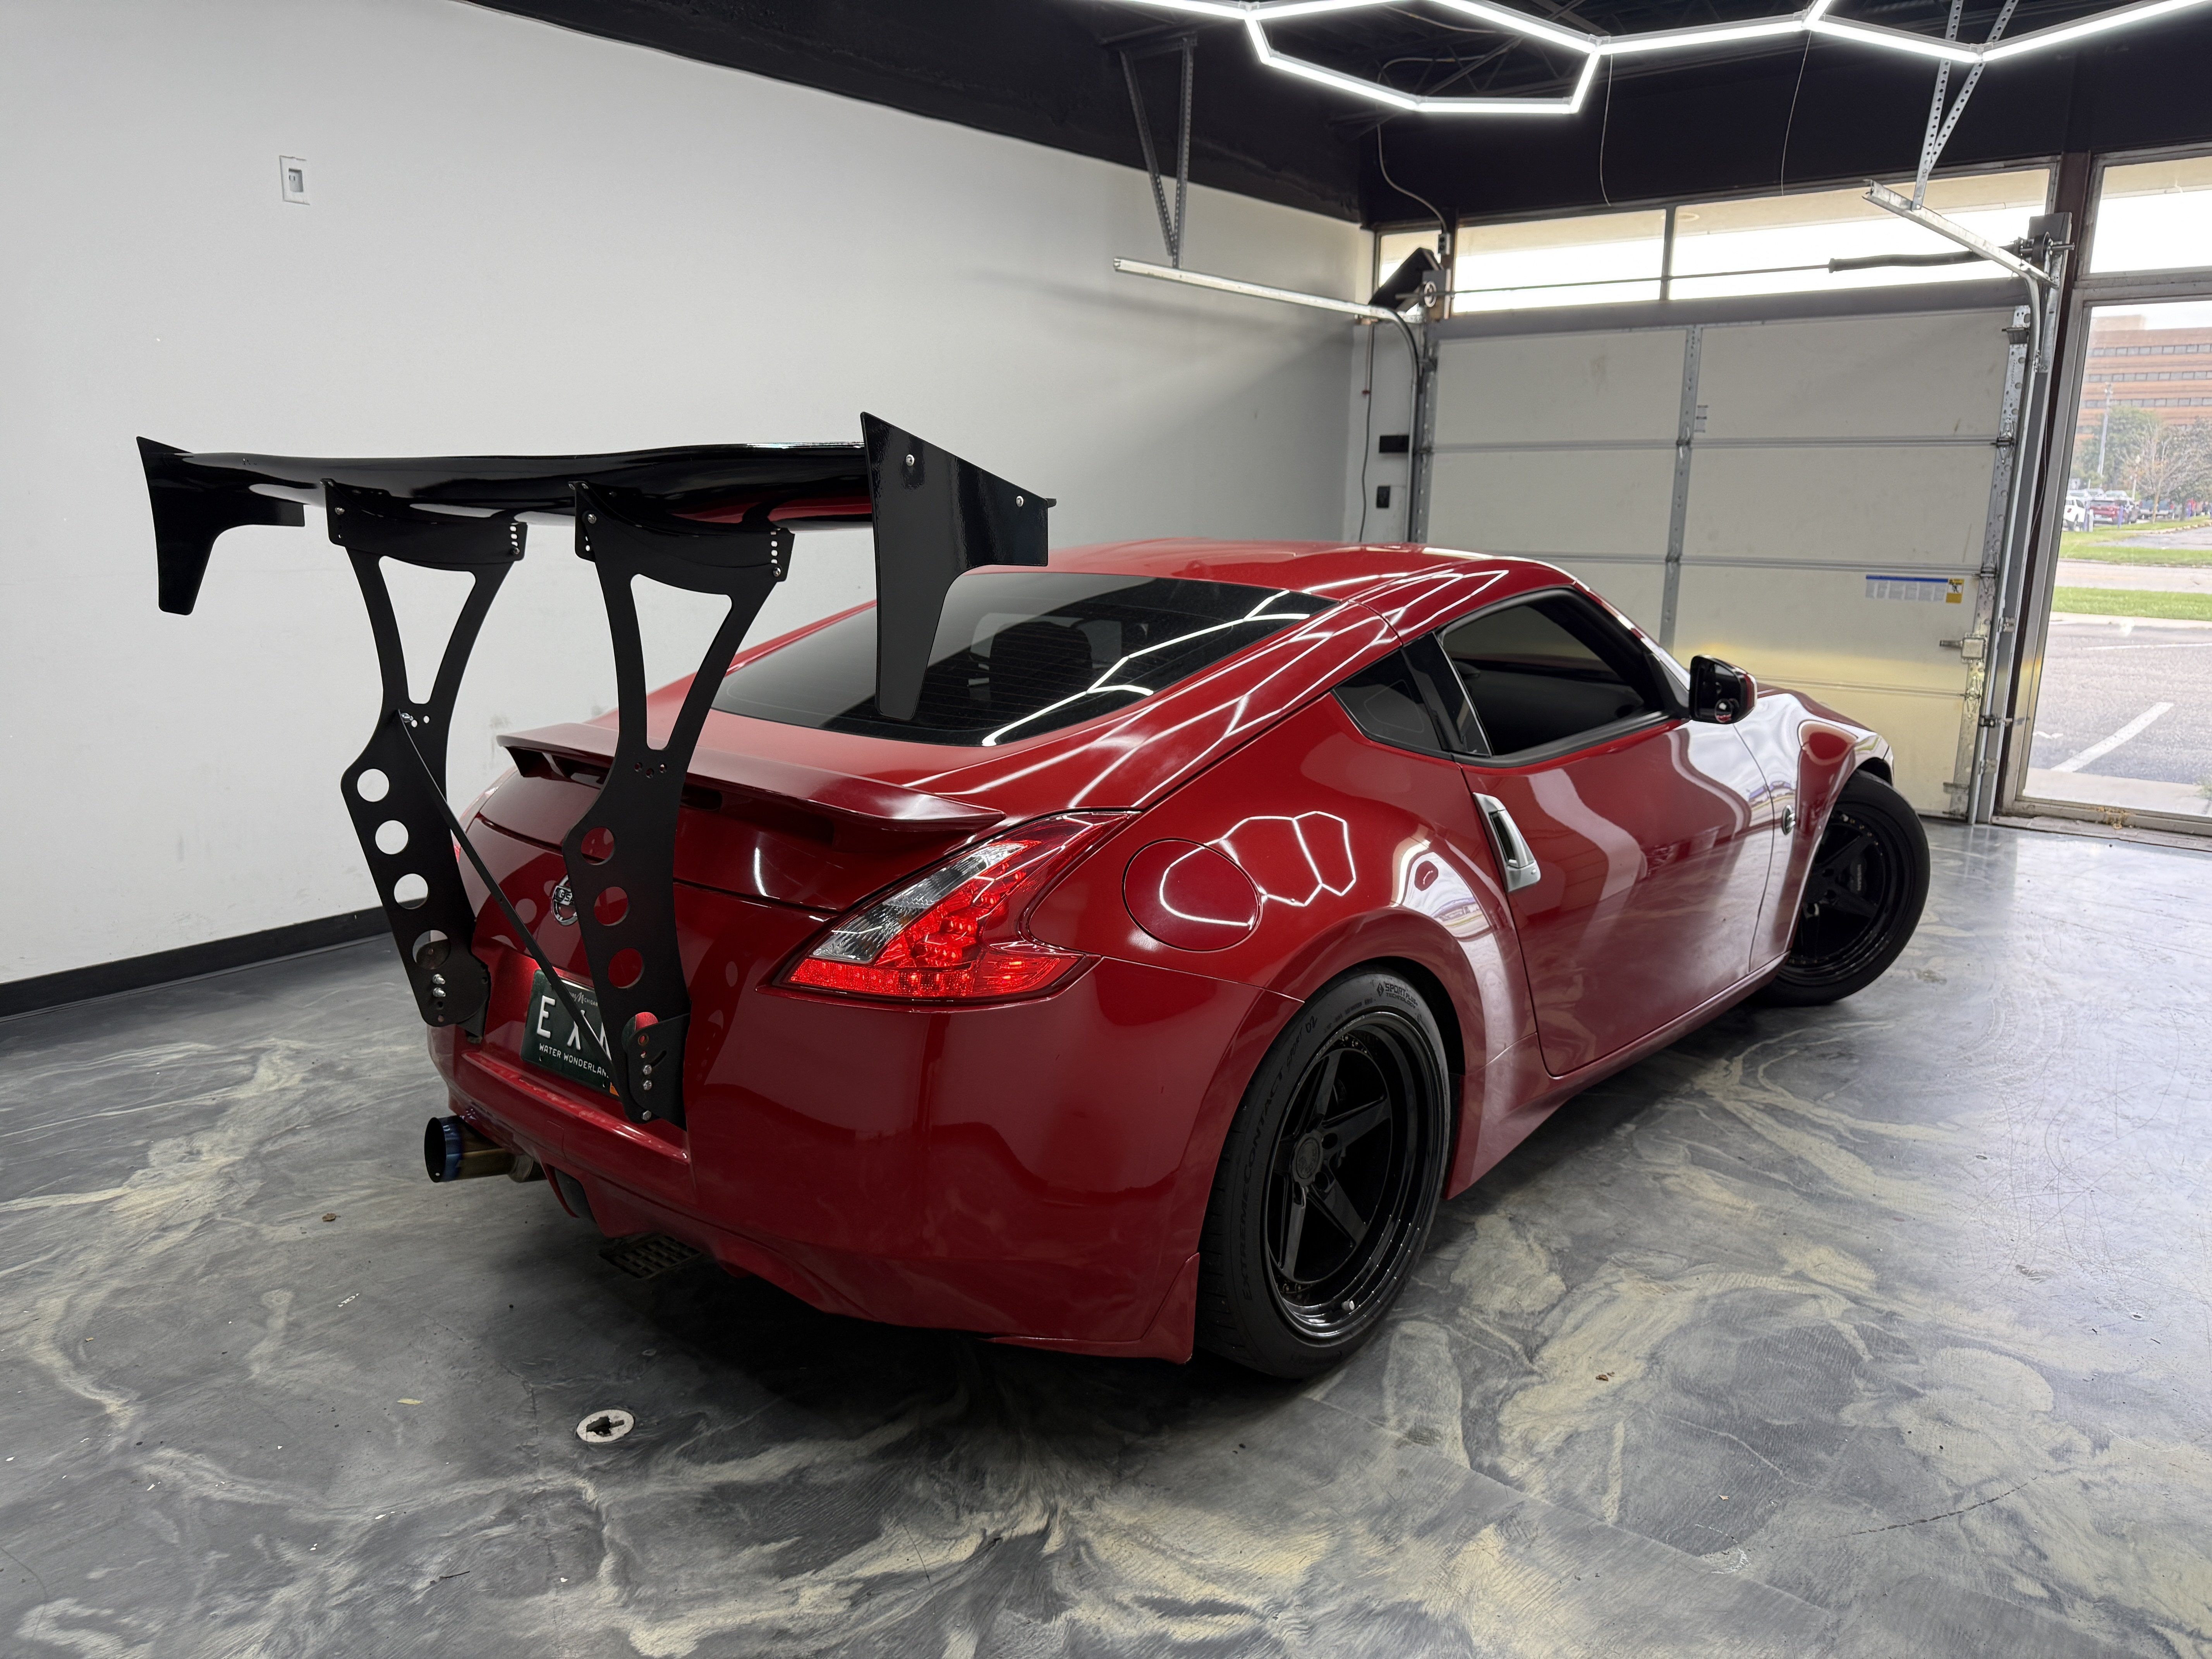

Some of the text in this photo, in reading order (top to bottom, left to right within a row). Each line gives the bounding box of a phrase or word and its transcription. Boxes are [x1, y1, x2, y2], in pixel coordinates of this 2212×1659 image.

[1385, 982, 1406, 996] SPORT
[574, 992, 598, 1006] MICHIGAN
[1386, 993, 1416, 1008] TECHNOLOGY
[539, 1043, 609, 1079] WATER WONDERLAN
